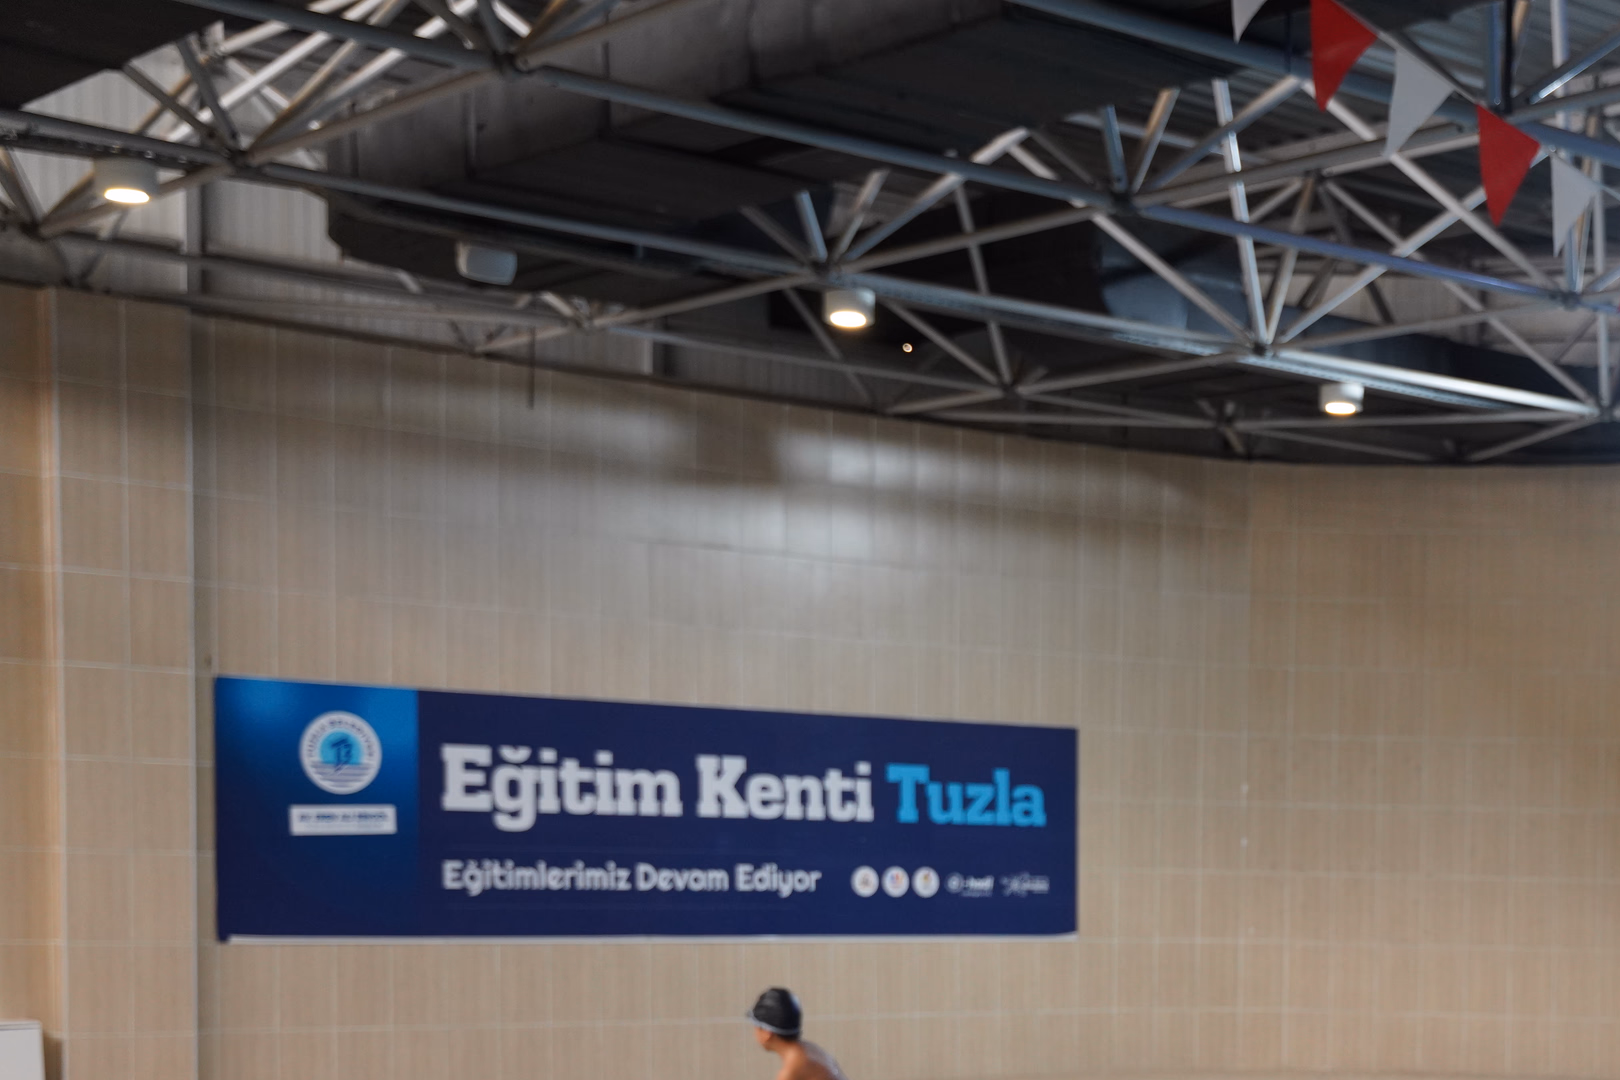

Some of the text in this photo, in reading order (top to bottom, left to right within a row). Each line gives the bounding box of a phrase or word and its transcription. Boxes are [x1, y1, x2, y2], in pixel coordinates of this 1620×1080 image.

[441, 742, 1047, 832] Eğitim Kenti Tuzla
[441, 858, 823, 898] Eğitimlerimiz Devam Ediyor
